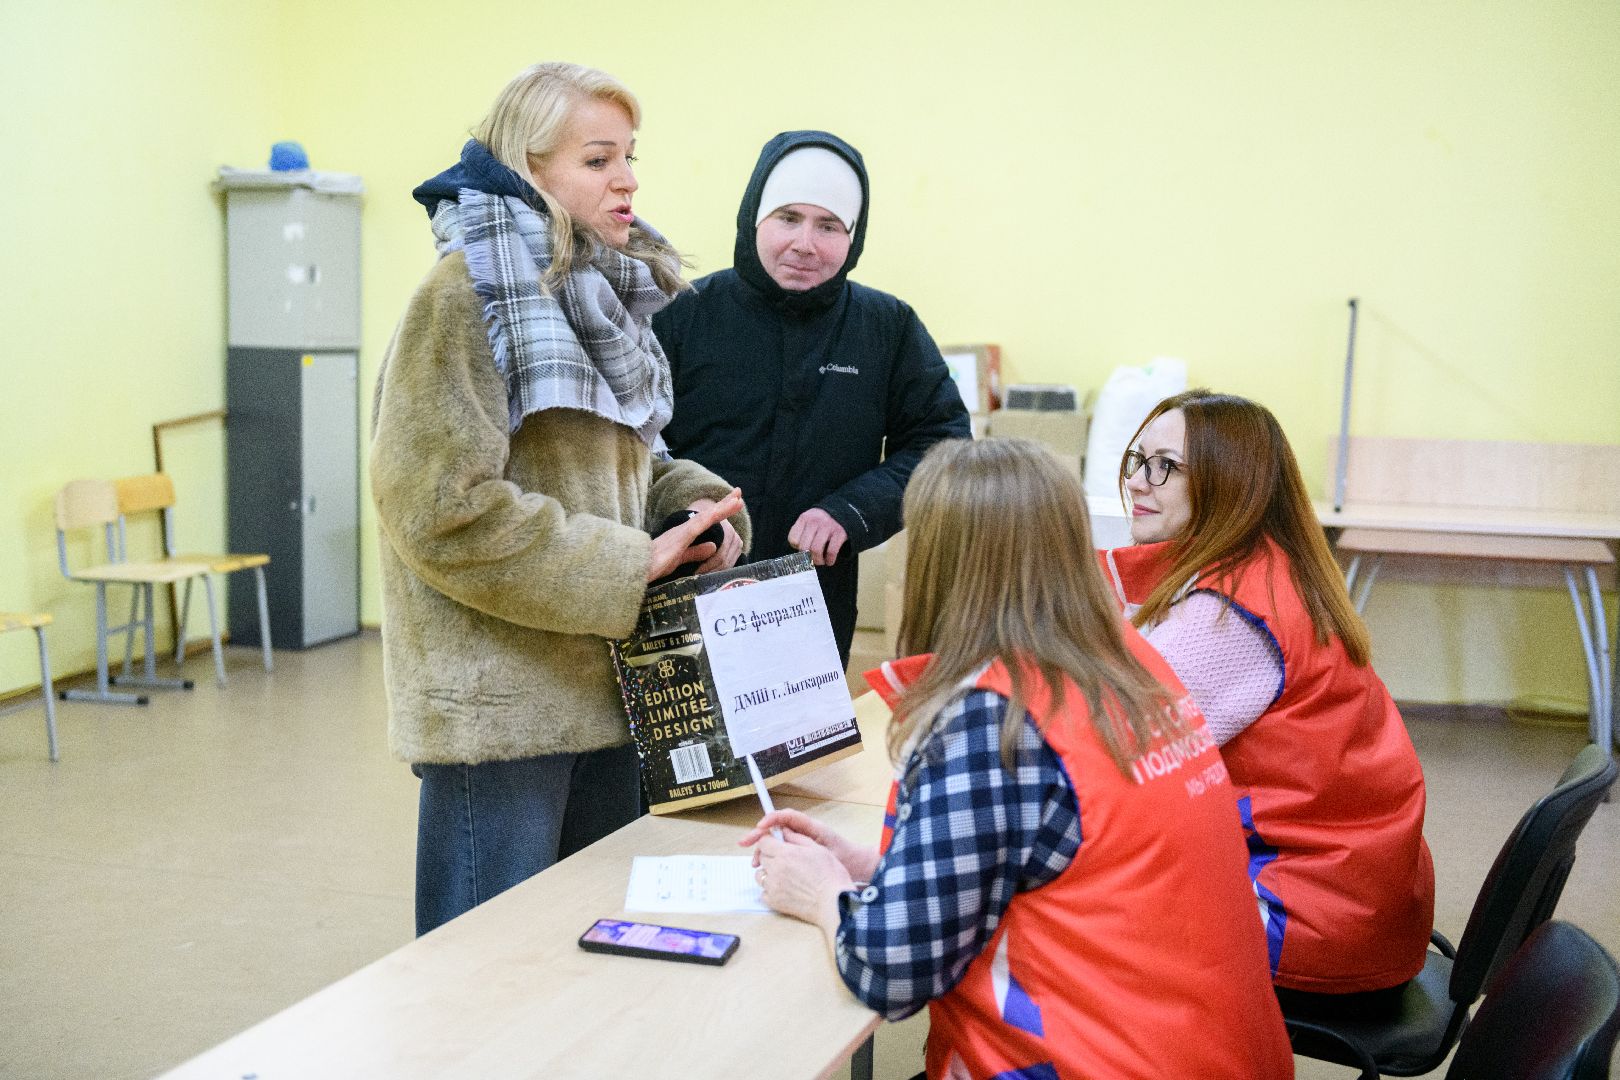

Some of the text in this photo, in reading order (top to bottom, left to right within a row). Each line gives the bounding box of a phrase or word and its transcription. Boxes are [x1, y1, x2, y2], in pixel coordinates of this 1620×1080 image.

[826, 363, 859, 375] Columbia
[714, 596, 817, 636] С 23 февраля!!!
[670, 637, 675, 646] 6
[645, 680, 705, 707] ÉDITION
[772, 689, 781, 700] г.
[783, 670, 839, 696] Лыткарино
[649, 696, 709, 724] LIMITÉE
[653, 715, 714, 741] DESIGN
[669, 785, 694, 799] BAILEYS
[696, 783, 701, 793] 6
[708, 778, 729, 790] 700ml
